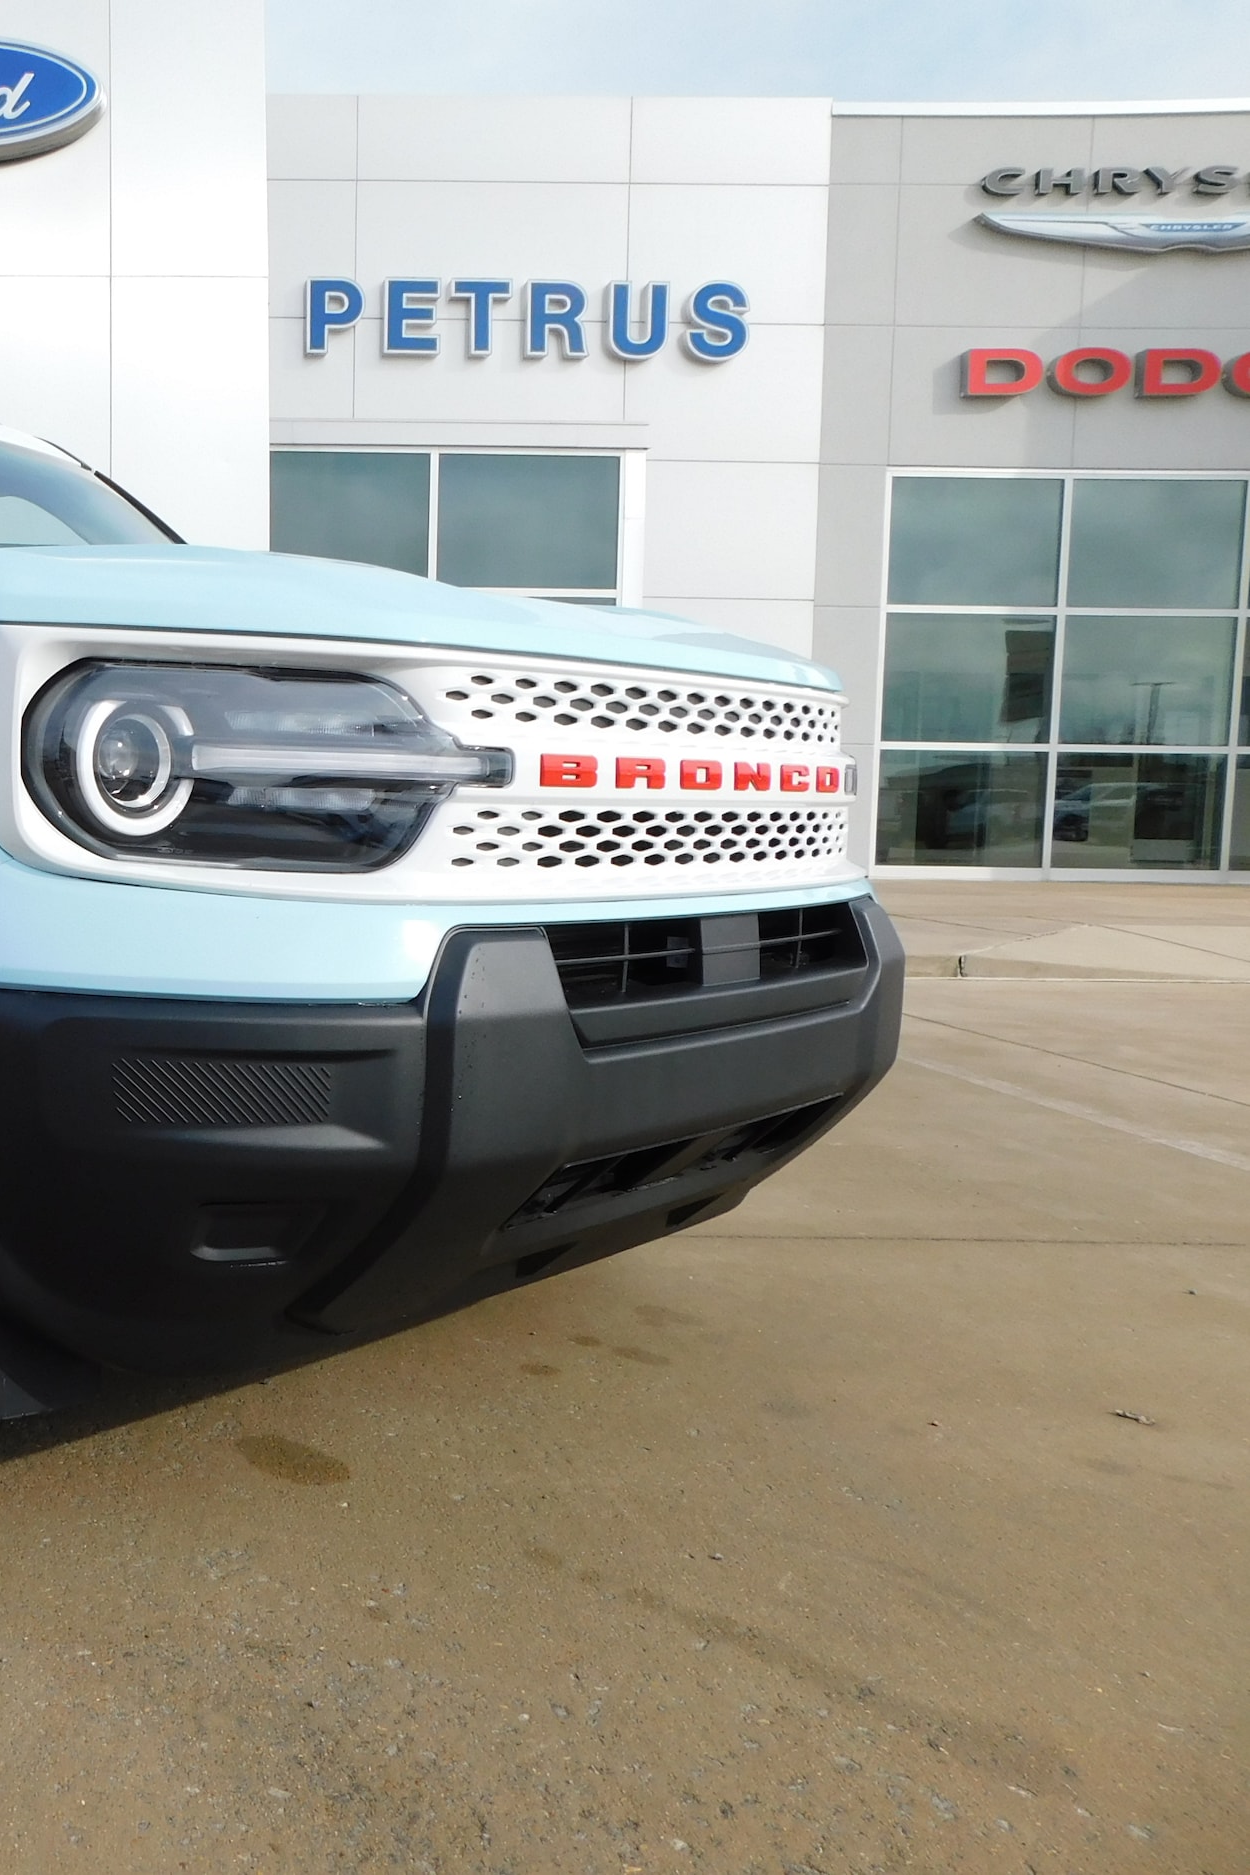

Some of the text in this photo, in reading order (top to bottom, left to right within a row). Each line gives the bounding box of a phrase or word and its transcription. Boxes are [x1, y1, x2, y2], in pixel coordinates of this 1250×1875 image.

[980, 165, 1250, 196] CHRYS
[1149, 223, 1233, 231] CHRYSLER
[304, 276, 751, 363] PETRUS
[960, 347, 1250, 399] DOD
[538, 753, 840, 793] BRONCO
